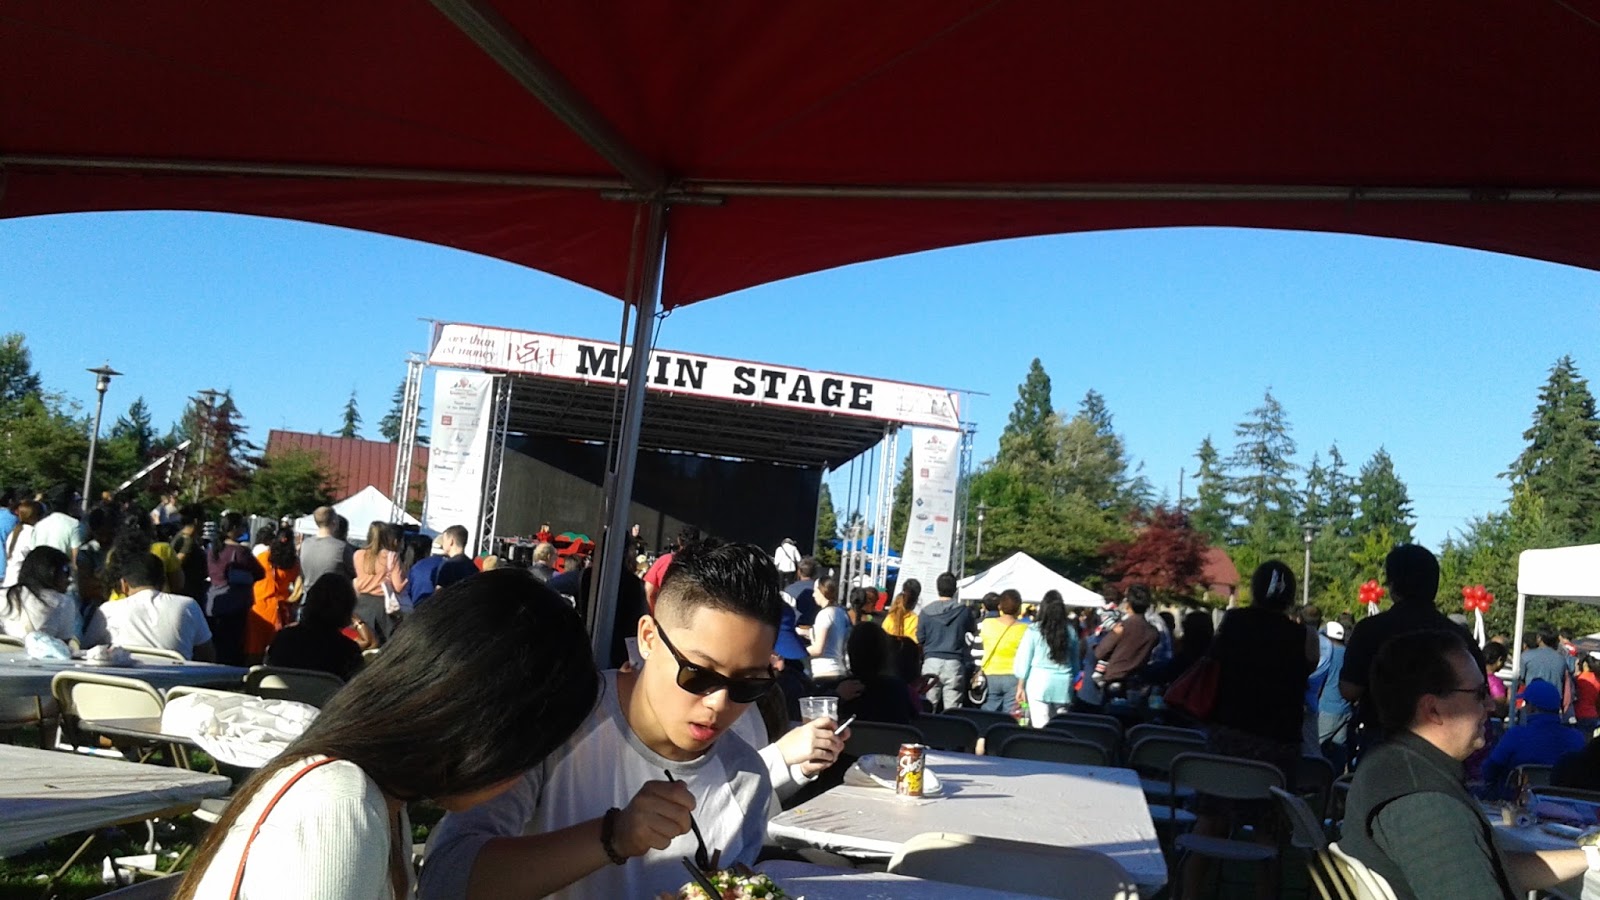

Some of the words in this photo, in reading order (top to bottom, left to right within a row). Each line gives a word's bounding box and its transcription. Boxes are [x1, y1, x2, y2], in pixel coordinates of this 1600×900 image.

[469, 334, 496, 348] than
[576, 344, 708, 390] MIN
[733, 366, 873, 411] STAGE
